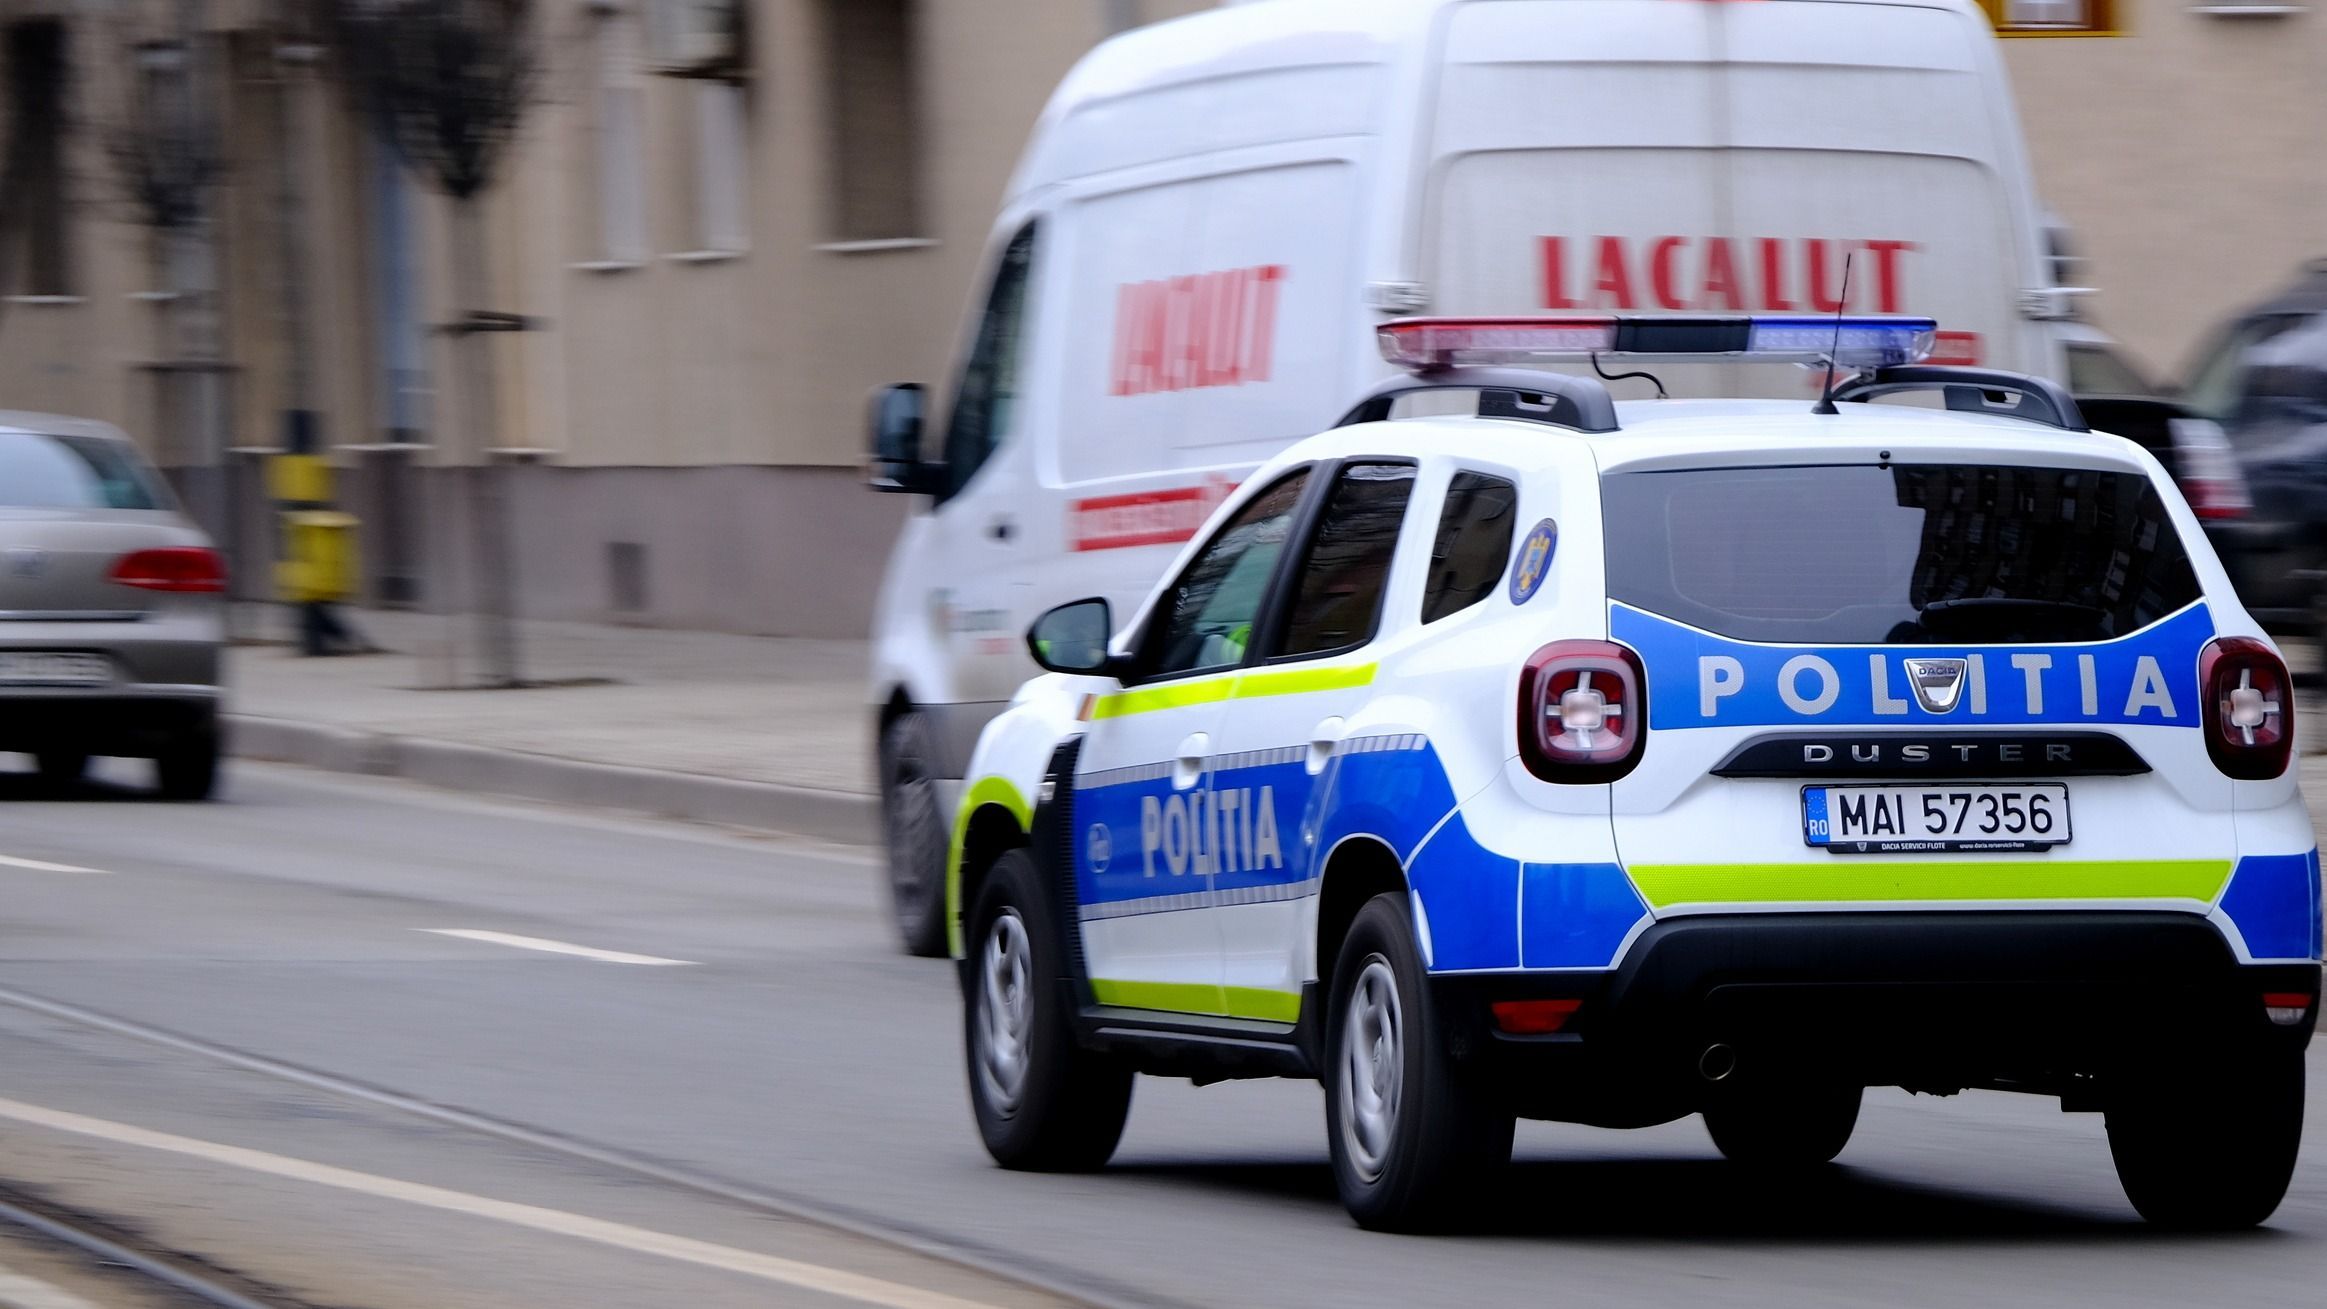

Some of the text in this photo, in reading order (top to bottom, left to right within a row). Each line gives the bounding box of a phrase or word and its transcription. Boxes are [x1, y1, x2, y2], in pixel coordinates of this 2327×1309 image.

[1536, 234, 1922, 314] LACALUT
[1699, 653, 2178, 718] POLITIA
[1918, 667, 1957, 676] DACIA
[1803, 744, 2072, 763] DUSTER
[1809, 819, 1829, 836] RO
[1839, 792, 2053, 836] MAI 57356
[1141, 785, 1283, 878] POLITIA
[1881, 842, 1900, 850] DACIA
[1927, 842, 1946, 850] FLOTE
